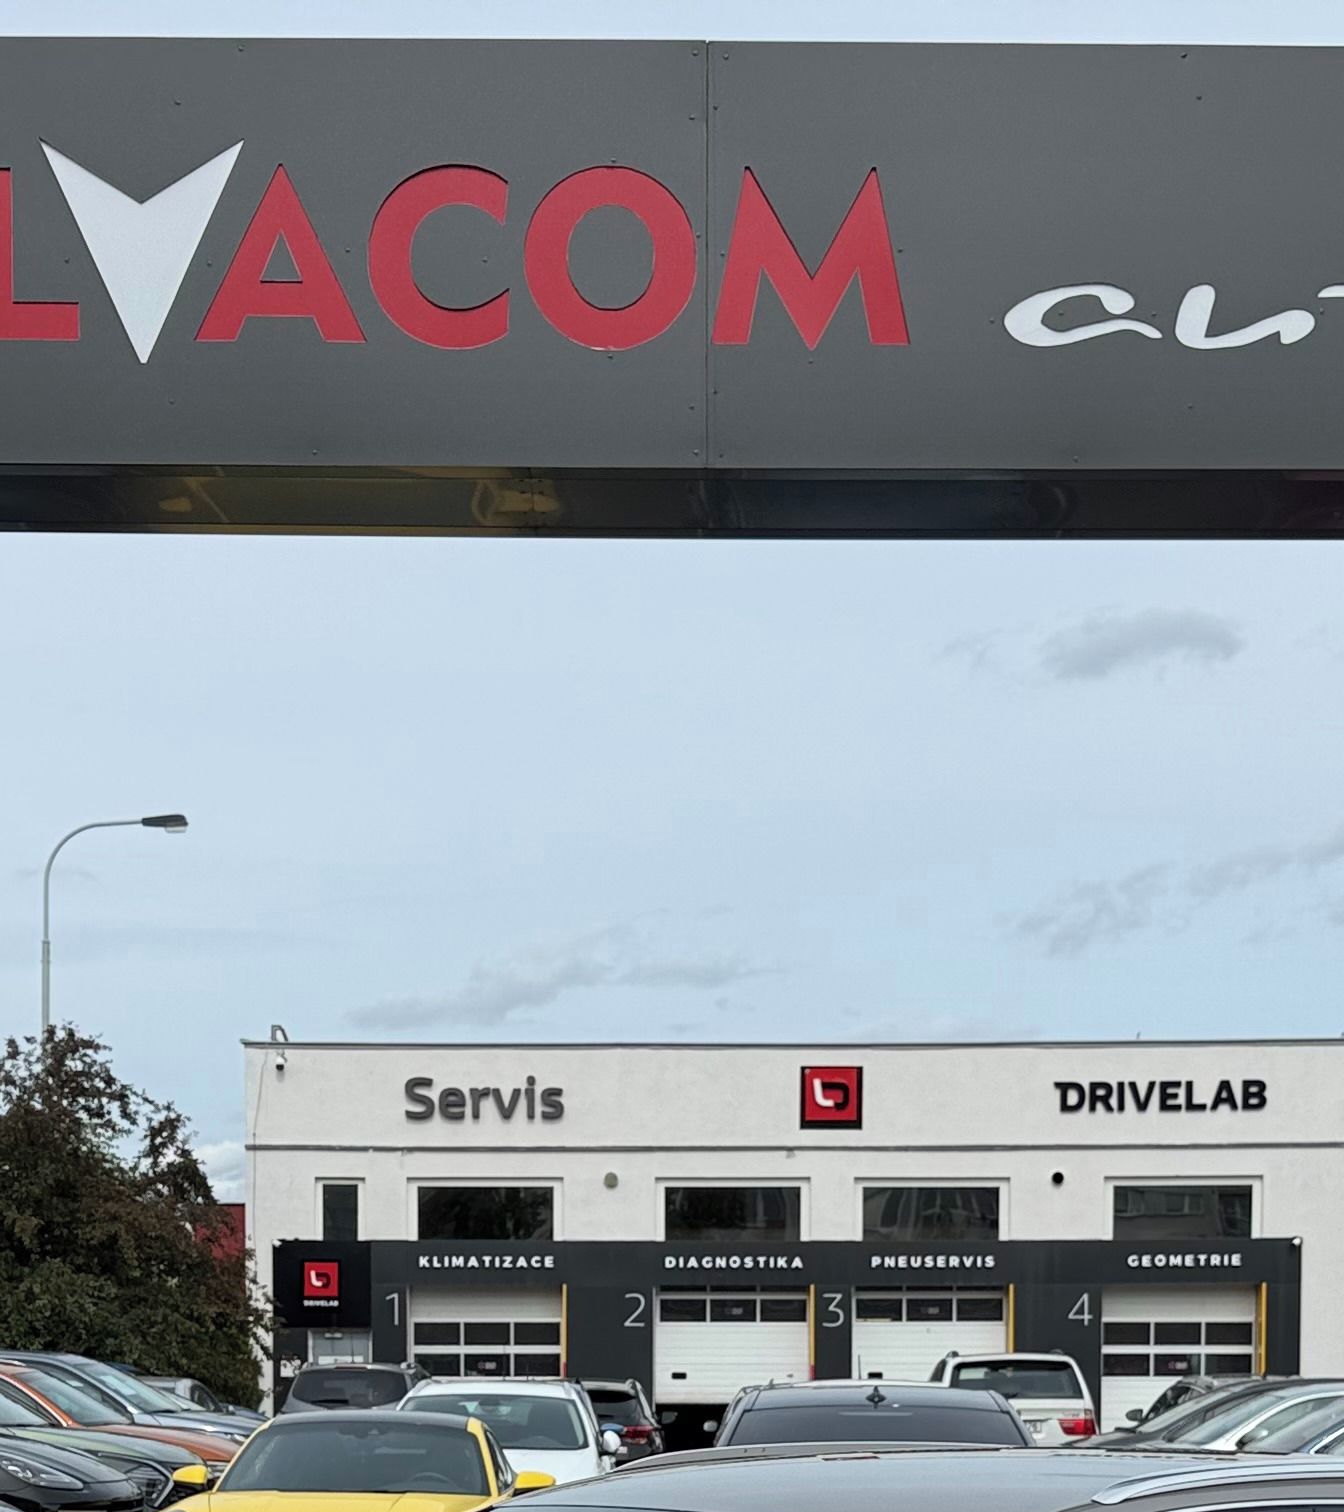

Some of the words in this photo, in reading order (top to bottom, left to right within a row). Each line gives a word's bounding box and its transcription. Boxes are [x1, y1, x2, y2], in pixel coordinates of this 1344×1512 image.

[404, 1075, 565, 1123] Servis
[1053, 1079, 1268, 1114] DRIVELAB
[418, 1255, 555, 1268] KLIMATIZACE
[664, 1255, 804, 1269] DIAGNOSTIKA
[870, 1255, 996, 1268] PNEUSERVIS
[1127, 1253, 1242, 1268] GEOMETRIE
[385, 1292, 399, 1326] 1
[623, 1292, 646, 1327] 2
[822, 1293, 845, 1328] 3
[1067, 1292, 1093, 1326] 4
